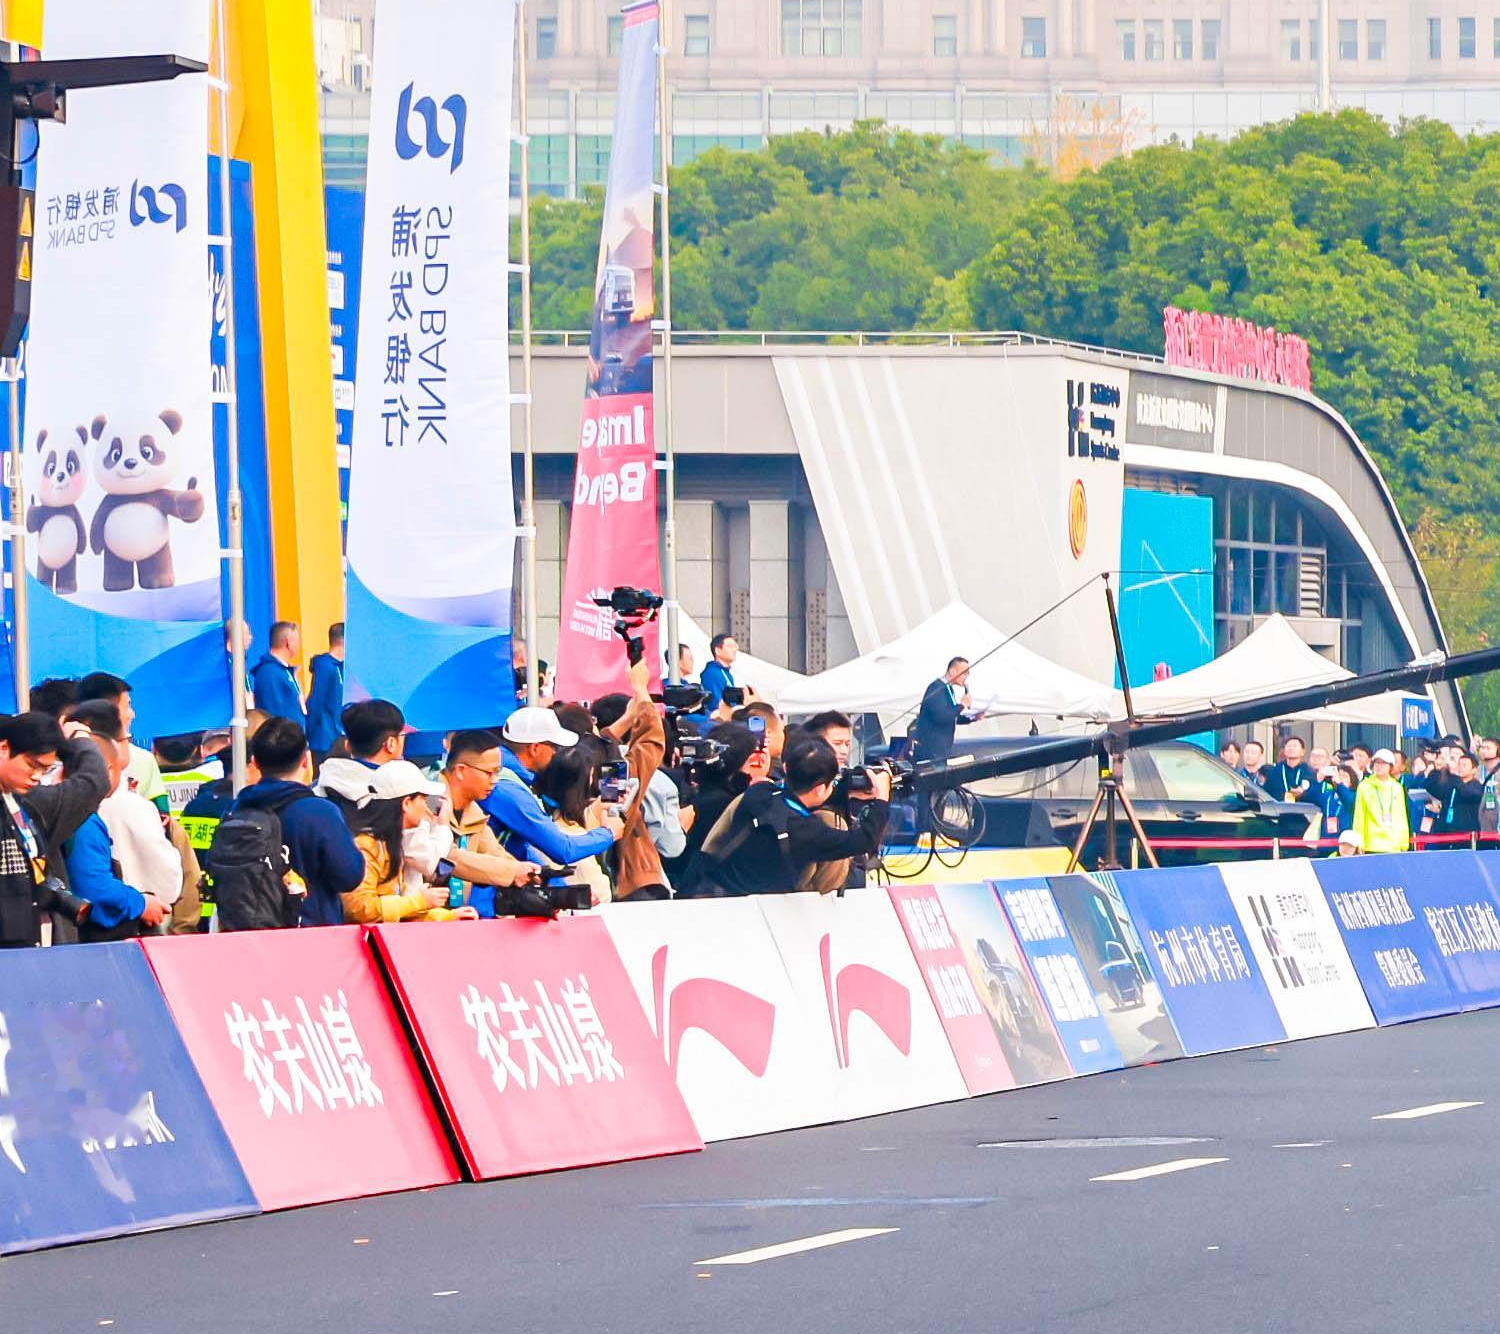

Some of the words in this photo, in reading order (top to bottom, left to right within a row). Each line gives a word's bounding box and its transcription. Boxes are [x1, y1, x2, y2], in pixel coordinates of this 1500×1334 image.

[1150, 924, 1252, 987] 杭州市体育局
[224, 988, 384, 1119] 农夫山泉
[459, 973, 625, 1093] 农夫山泉
